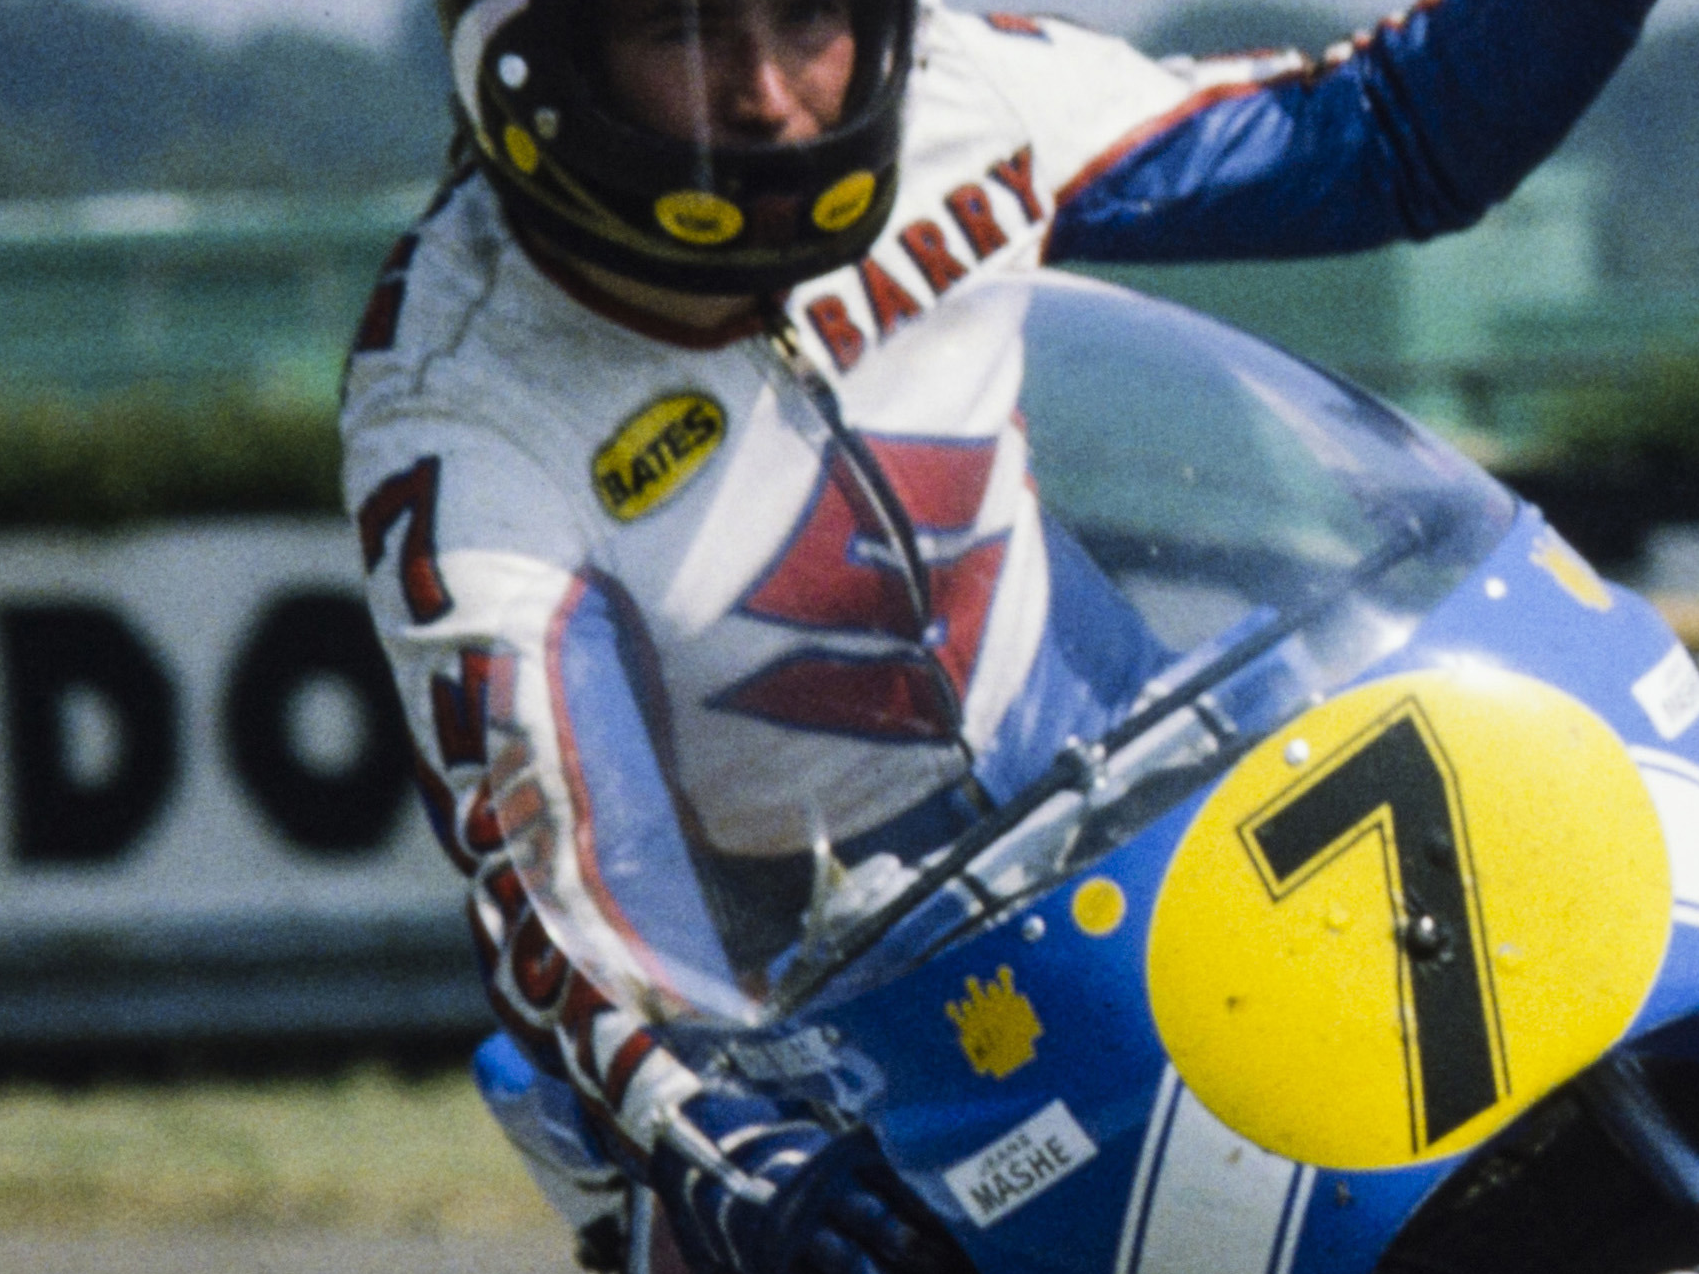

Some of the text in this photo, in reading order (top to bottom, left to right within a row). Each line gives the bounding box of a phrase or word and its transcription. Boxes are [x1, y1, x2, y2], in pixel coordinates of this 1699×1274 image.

[805, 142, 1044, 377] BARRY
[358, 454, 456, 627] 7
[603, 403, 718, 508] BATES
[1236, 692, 1514, 1156] 7
[968, 1133, 1072, 1217] MASHE
